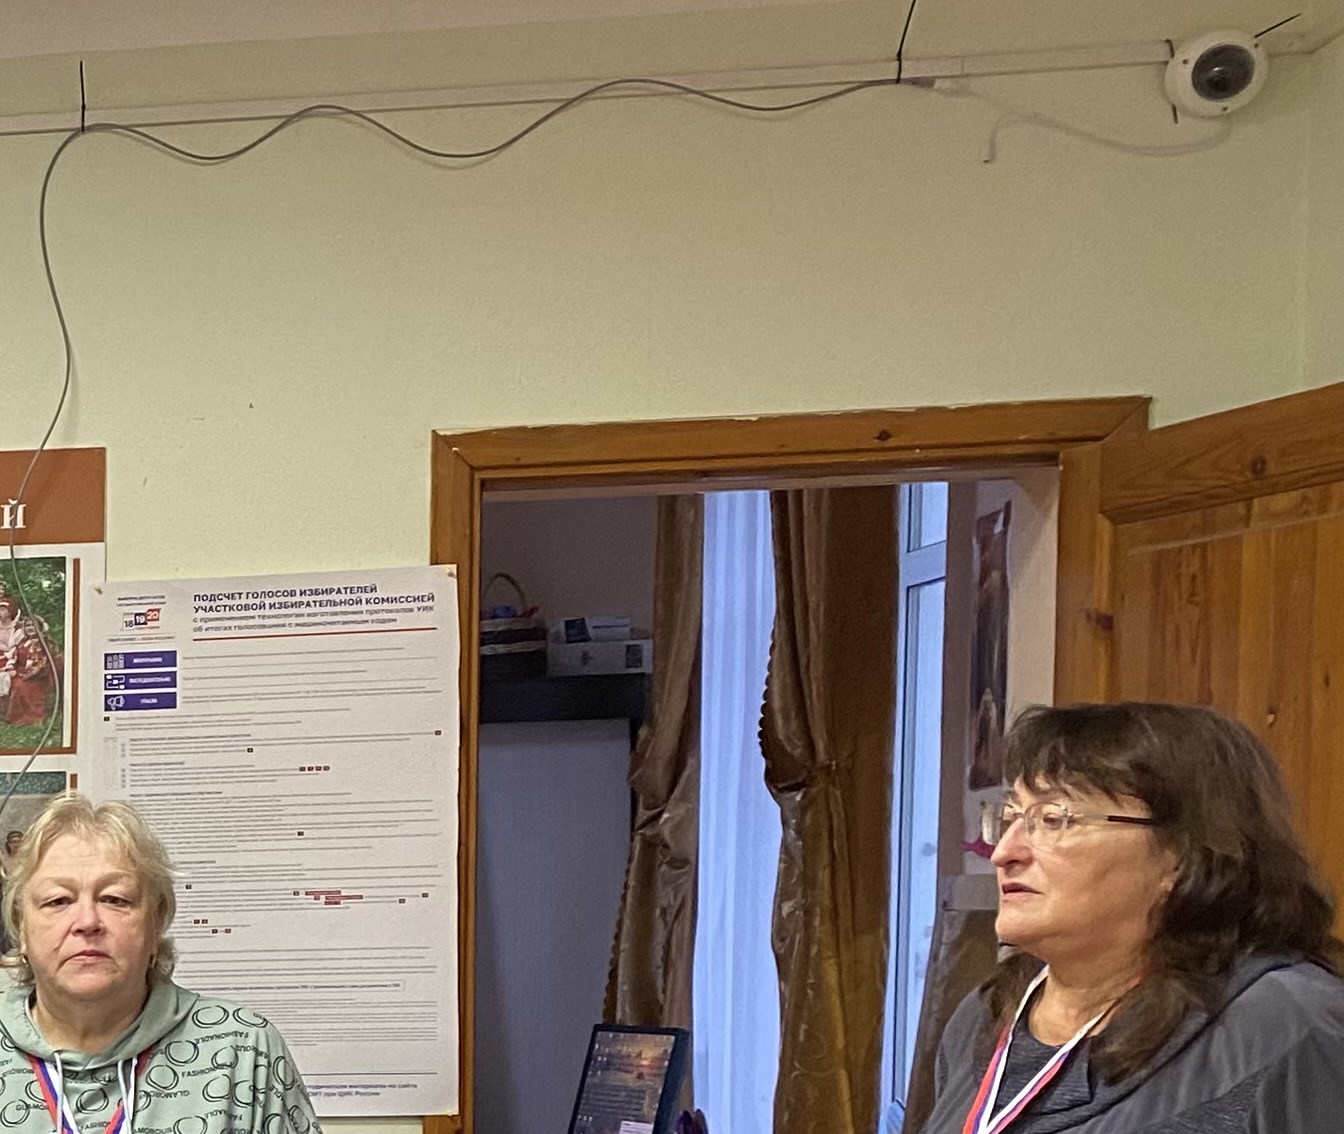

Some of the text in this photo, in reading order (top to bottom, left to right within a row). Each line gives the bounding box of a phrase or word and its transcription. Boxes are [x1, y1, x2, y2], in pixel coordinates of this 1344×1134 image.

[193, 584, 378, 603] ПОДСЧЕТ ГОЛОСОВ ИЗБИРАТЕЛЕЙ
[193, 592, 435, 614] УЧАСТКОВОЙ ИЗБИРАТЕЛЬНОЙ КОМИССИЕЙ
